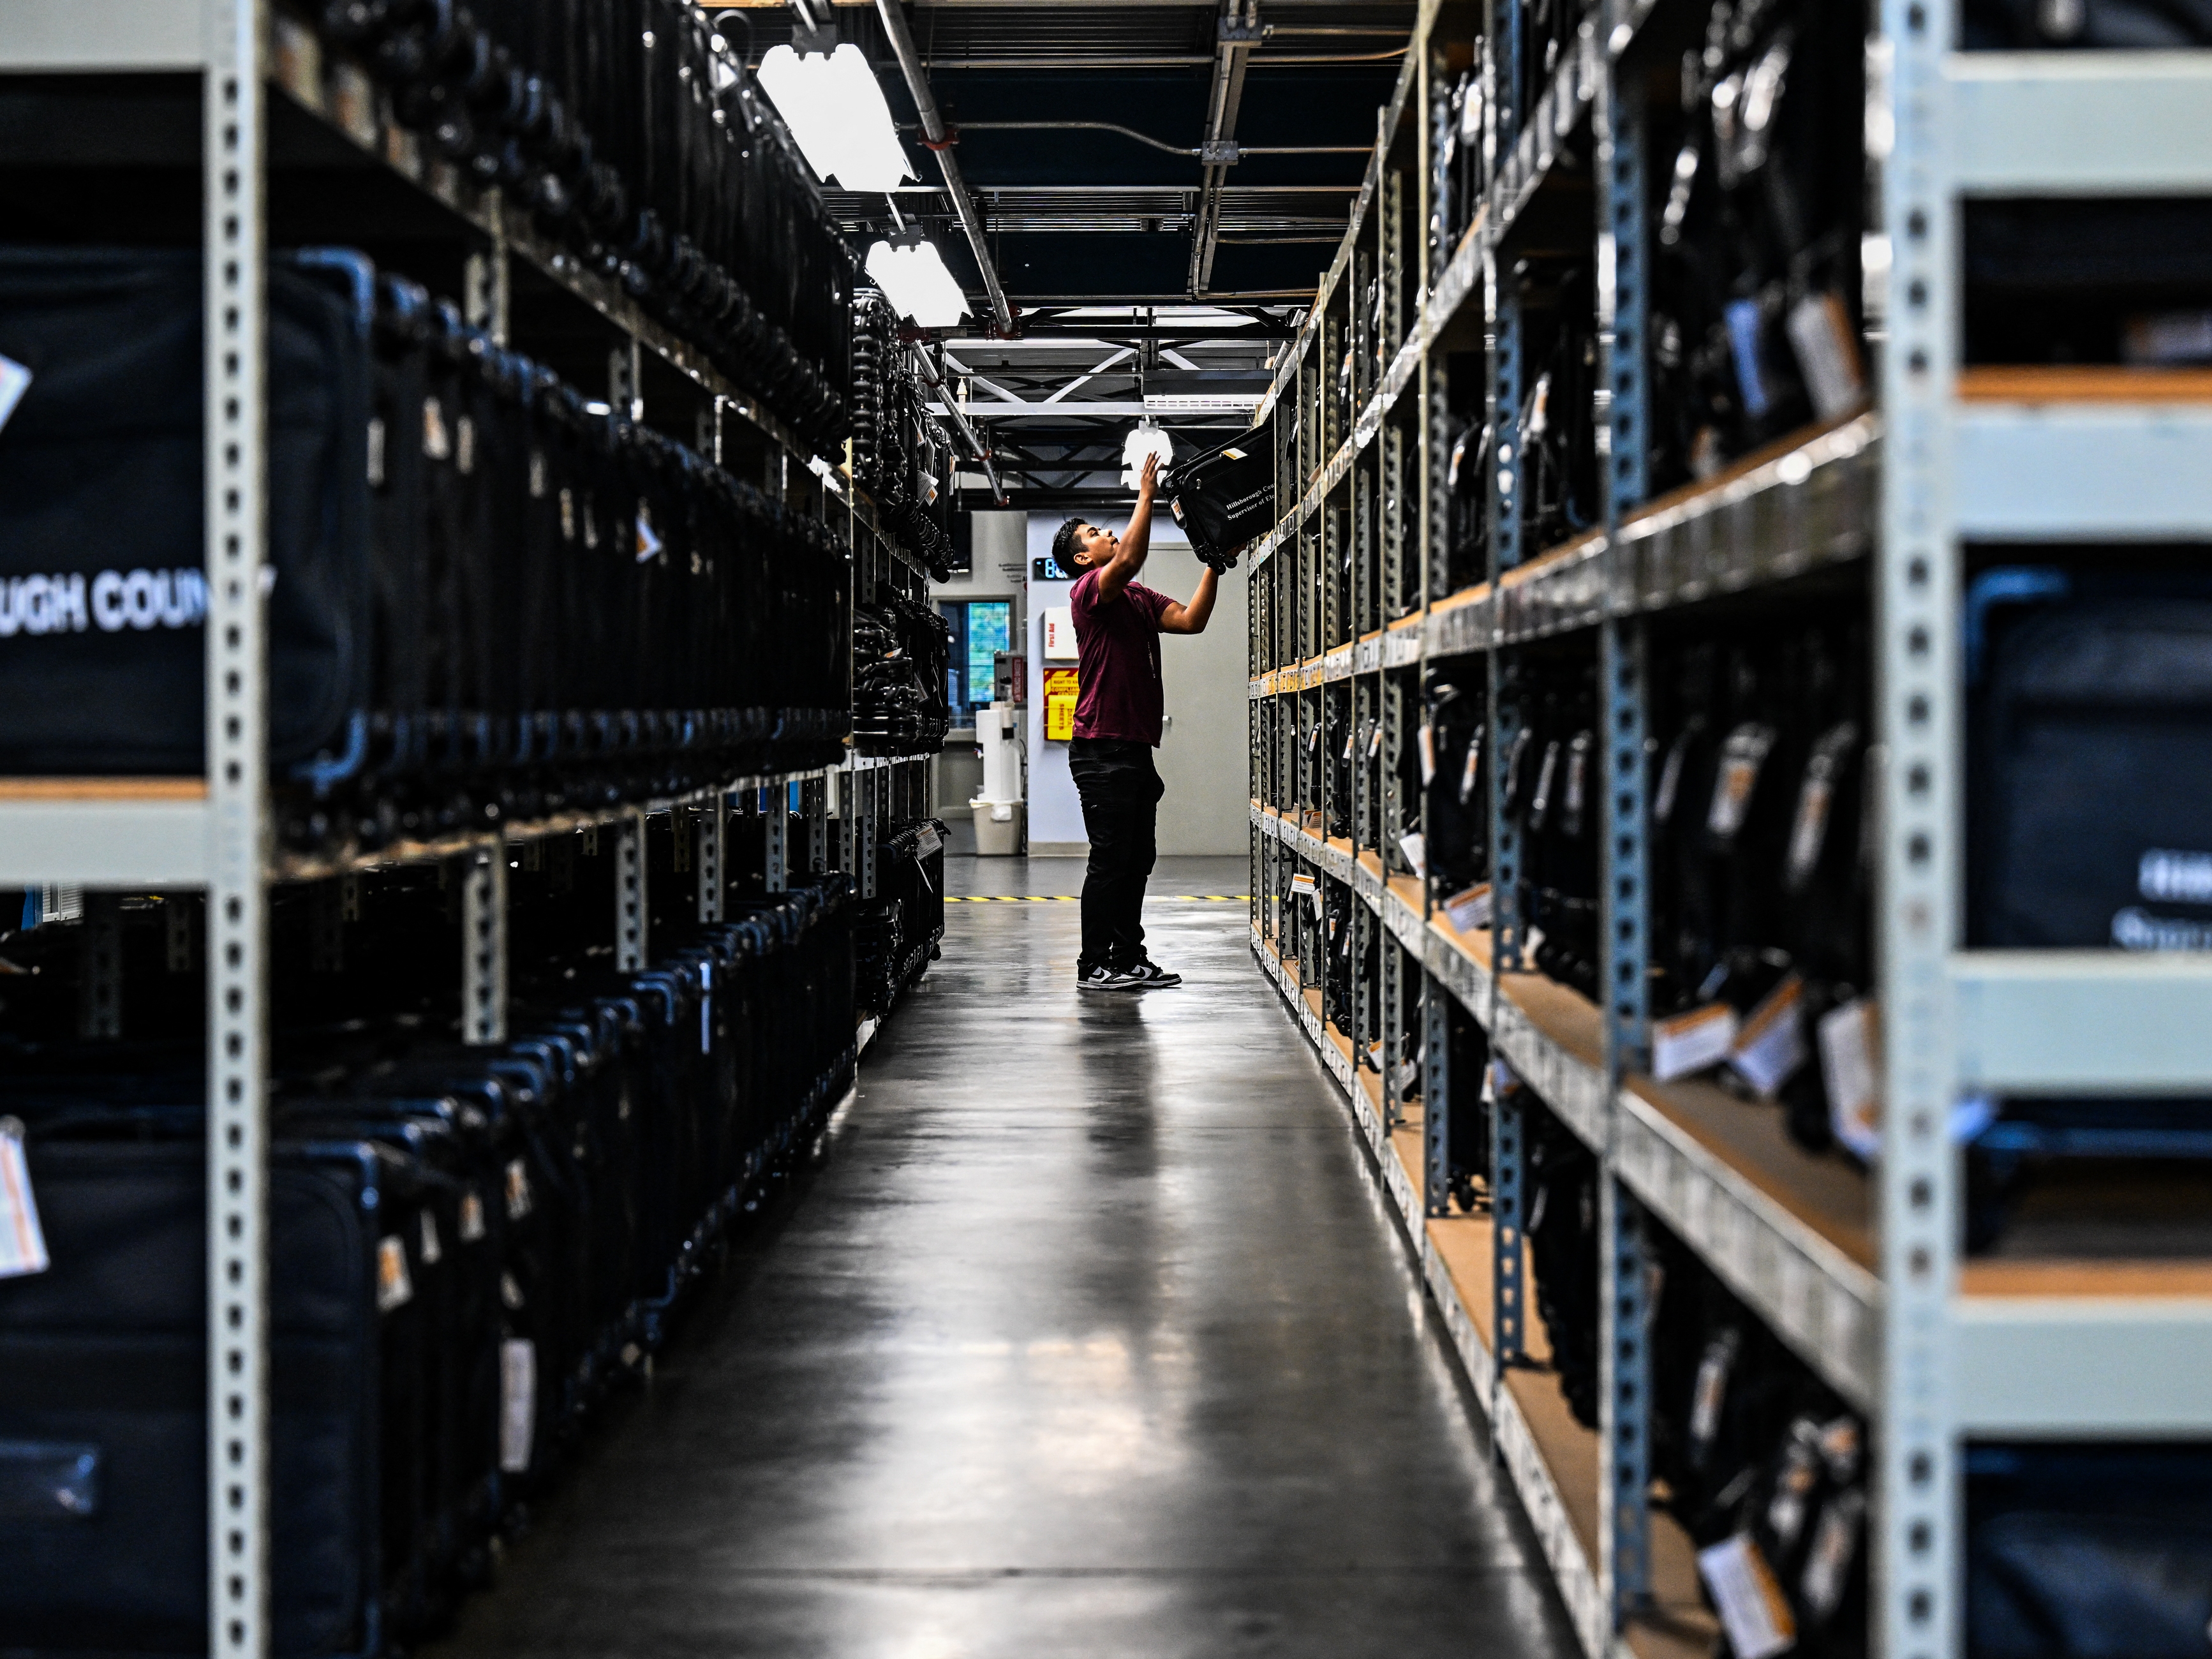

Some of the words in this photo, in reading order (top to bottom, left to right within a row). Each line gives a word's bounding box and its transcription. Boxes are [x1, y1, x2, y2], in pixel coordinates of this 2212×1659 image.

[1226, 490, 1262, 510] Hillsborough
[1263, 483, 1275, 492] Cou
[1228, 503, 1258, 520] Supervisor
[91, 567, 277, 632] COUN
